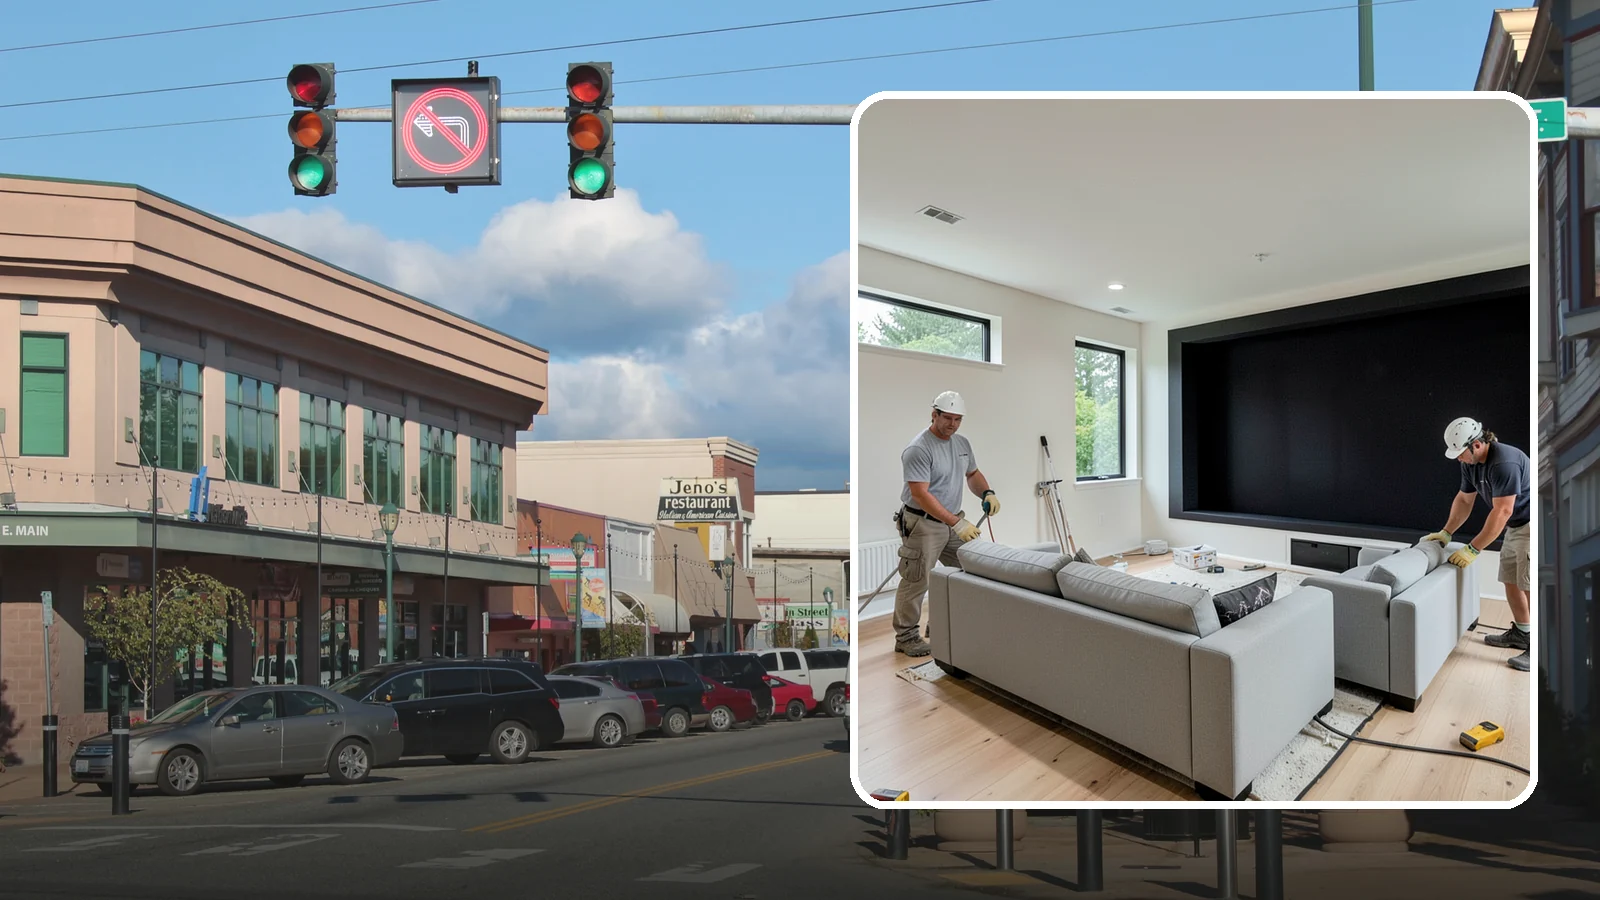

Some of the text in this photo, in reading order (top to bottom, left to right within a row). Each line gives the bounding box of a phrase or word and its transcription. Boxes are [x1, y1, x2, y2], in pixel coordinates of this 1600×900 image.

[669, 480, 728, 495] Jeno's
[665, 496, 731, 509] restaurant
[715, 510, 738, 519] Cuisine
[2, 525, 49, 536] E. MAIN
[797, 608, 828, 617] Street
